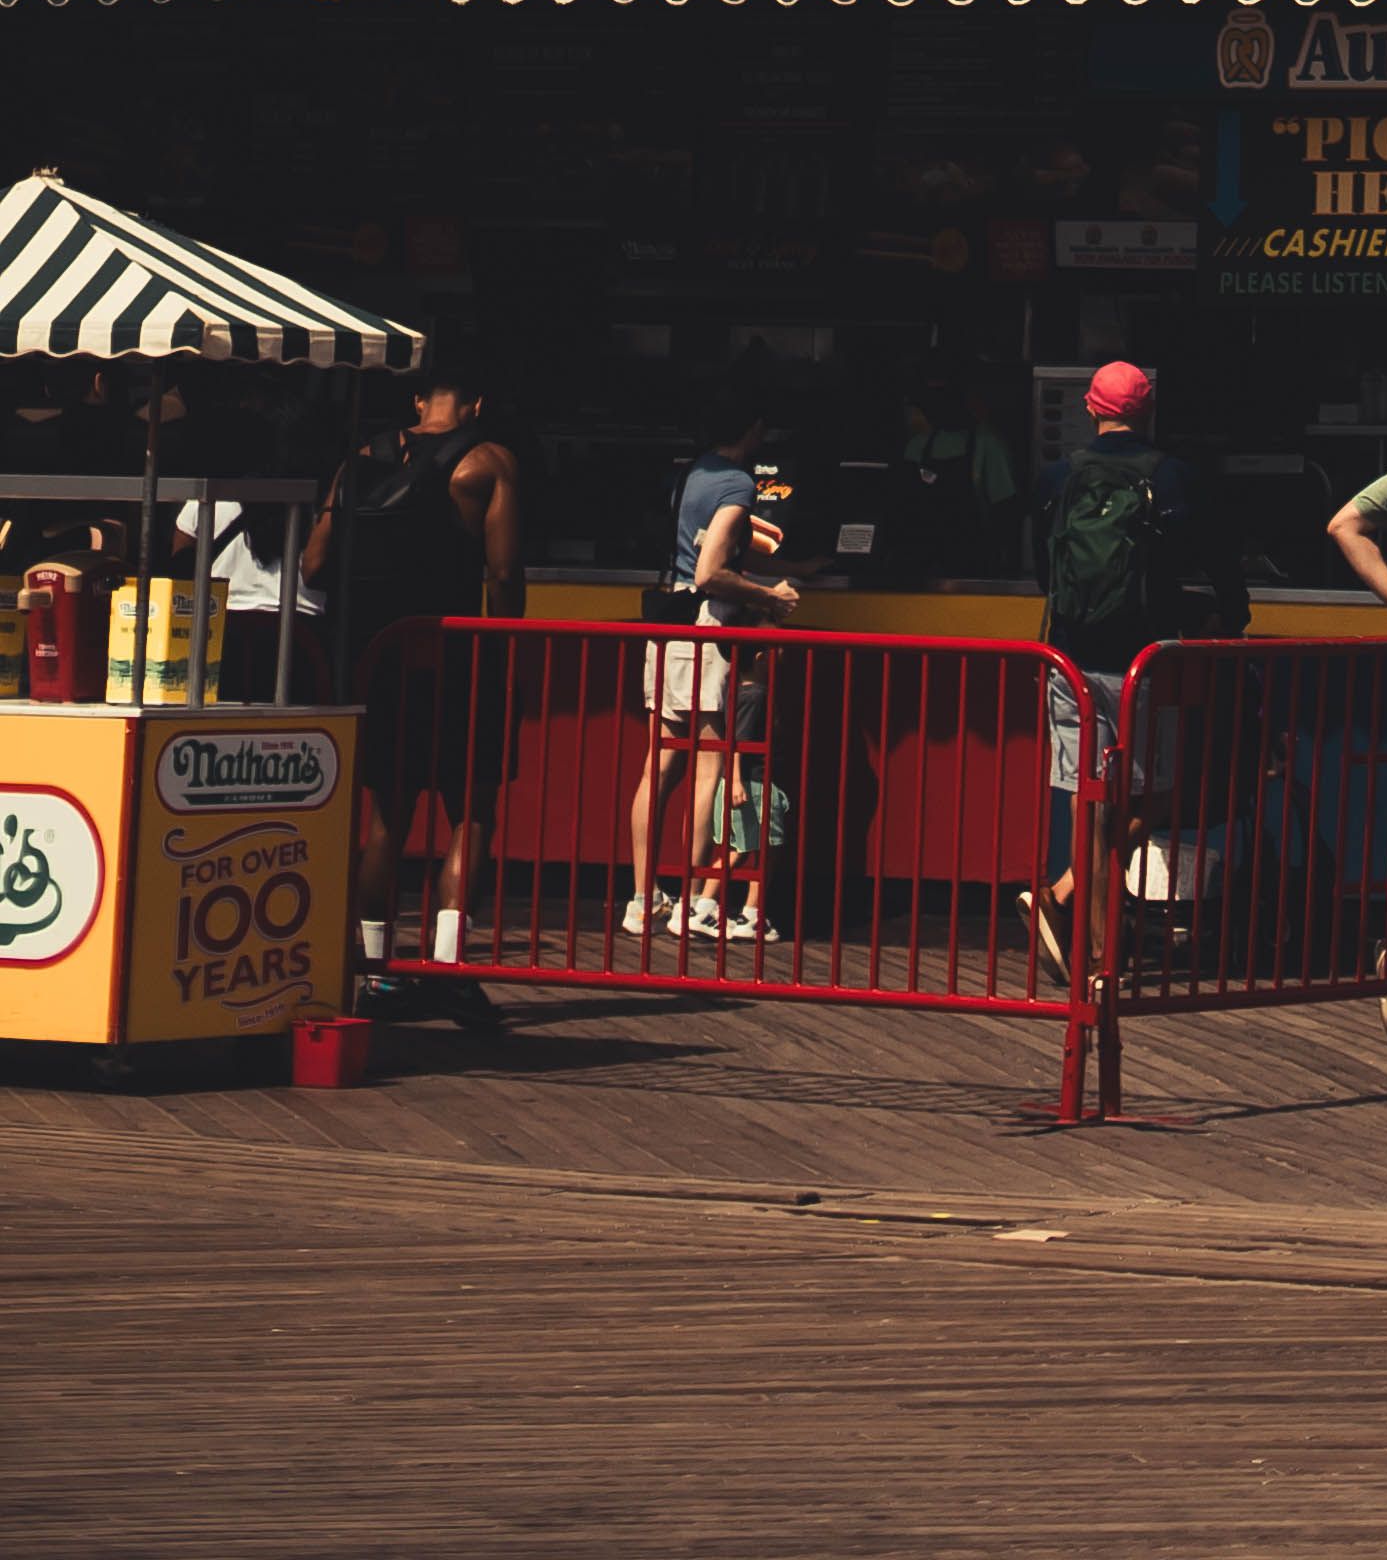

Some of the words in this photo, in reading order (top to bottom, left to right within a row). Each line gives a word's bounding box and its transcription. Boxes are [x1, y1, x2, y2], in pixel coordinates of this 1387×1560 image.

[1219, 271, 1303, 296] PLEASE
[172, 738, 324, 788] Nathan's
[180, 855, 233, 890] FOR
[240, 839, 310, 876] OVER
[176, 870, 312, 963] 100
[171, 941, 312, 1004] YEARS
